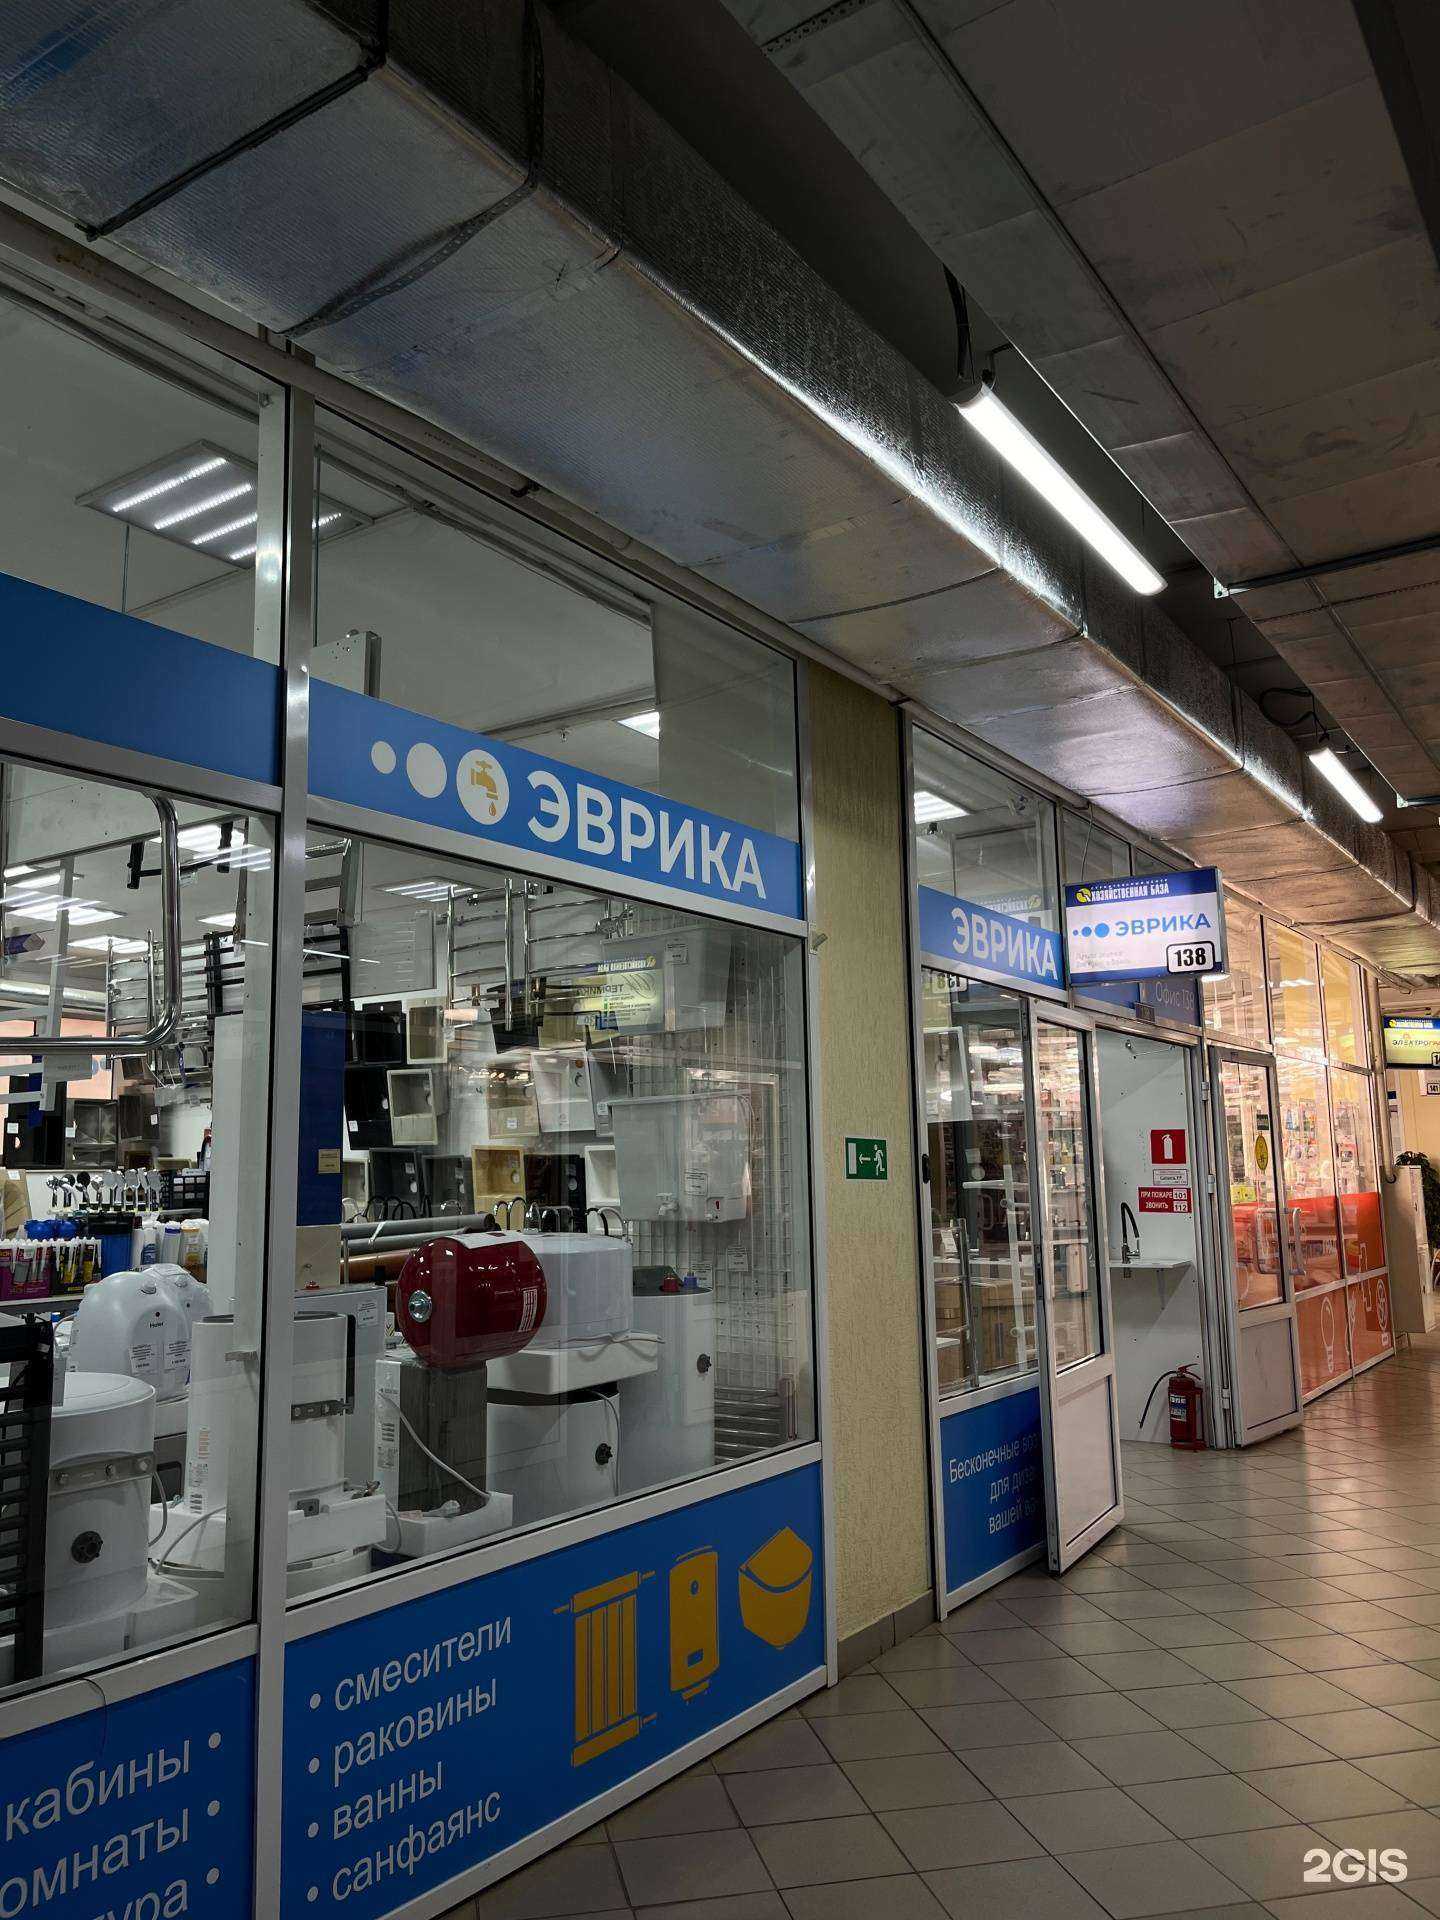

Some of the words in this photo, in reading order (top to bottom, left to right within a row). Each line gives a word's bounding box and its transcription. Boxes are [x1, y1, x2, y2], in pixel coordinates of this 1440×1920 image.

[527, 770, 767, 900] ЭВРИКА
[1150, 883, 1169, 896] БАЗА
[951, 907, 1058, 981] ЭВРИКА
[1115, 912, 1211, 937] ЭВРИКА
[1173, 947, 1207, 967] 138
[1155, 981, 1180, 1007] Офис
[1182, 989, 1195, 1010] 138
[1145, 1201, 1169, 1209] ЗВОНИТЬ
[1174, 1204, 1187, 1212] 112
[1151, 1191, 1173, 1199] ПОЖАРЕ
[949, 1440, 1020, 1484] Бесконечные
[990, 1476, 1009, 1504] для
[989, 1499, 1022, 1534] вашей
[334, 1616, 511, 1711] смесители
[333, 1678, 497, 1788] раковины
[6, 1739, 190, 1842] кабины
[333, 1761, 442, 1840] ванны
[332, 1791, 502, 1901] санфаянс
